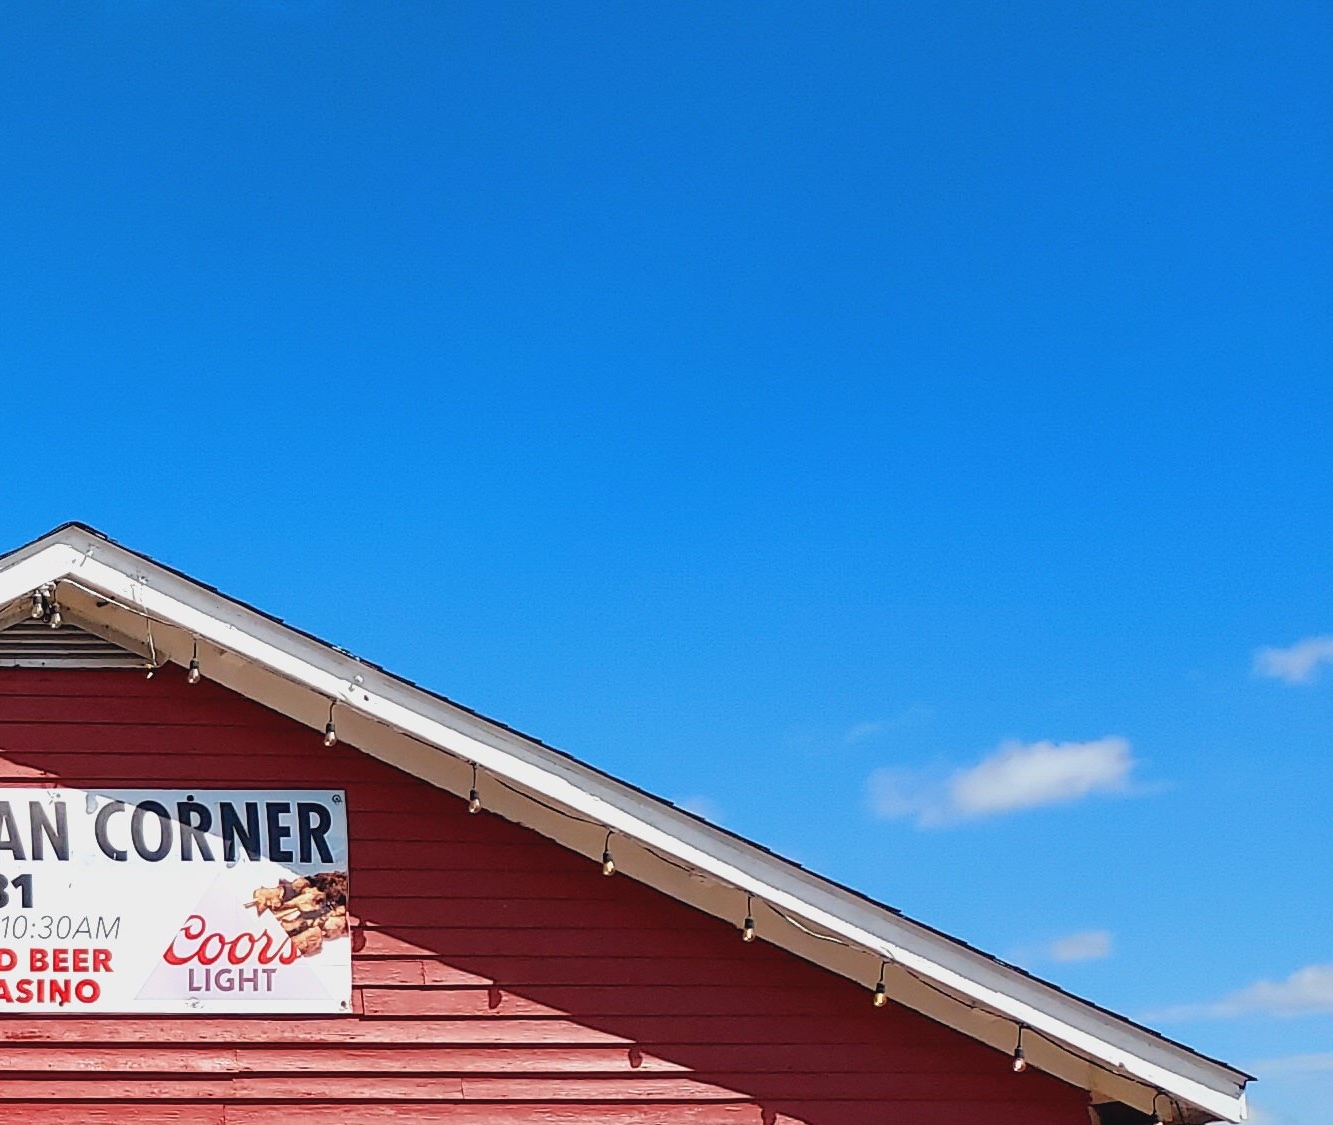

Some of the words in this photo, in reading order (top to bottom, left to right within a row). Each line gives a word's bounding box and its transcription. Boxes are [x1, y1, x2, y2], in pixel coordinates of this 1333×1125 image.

[94, 799, 333, 864] CORNER
[1, 915, 121, 941] 10:30AM
[163, 914, 302, 966] Coors
[31, 948, 114, 973] BEER
[188, 968, 278, 992] LIGHT
